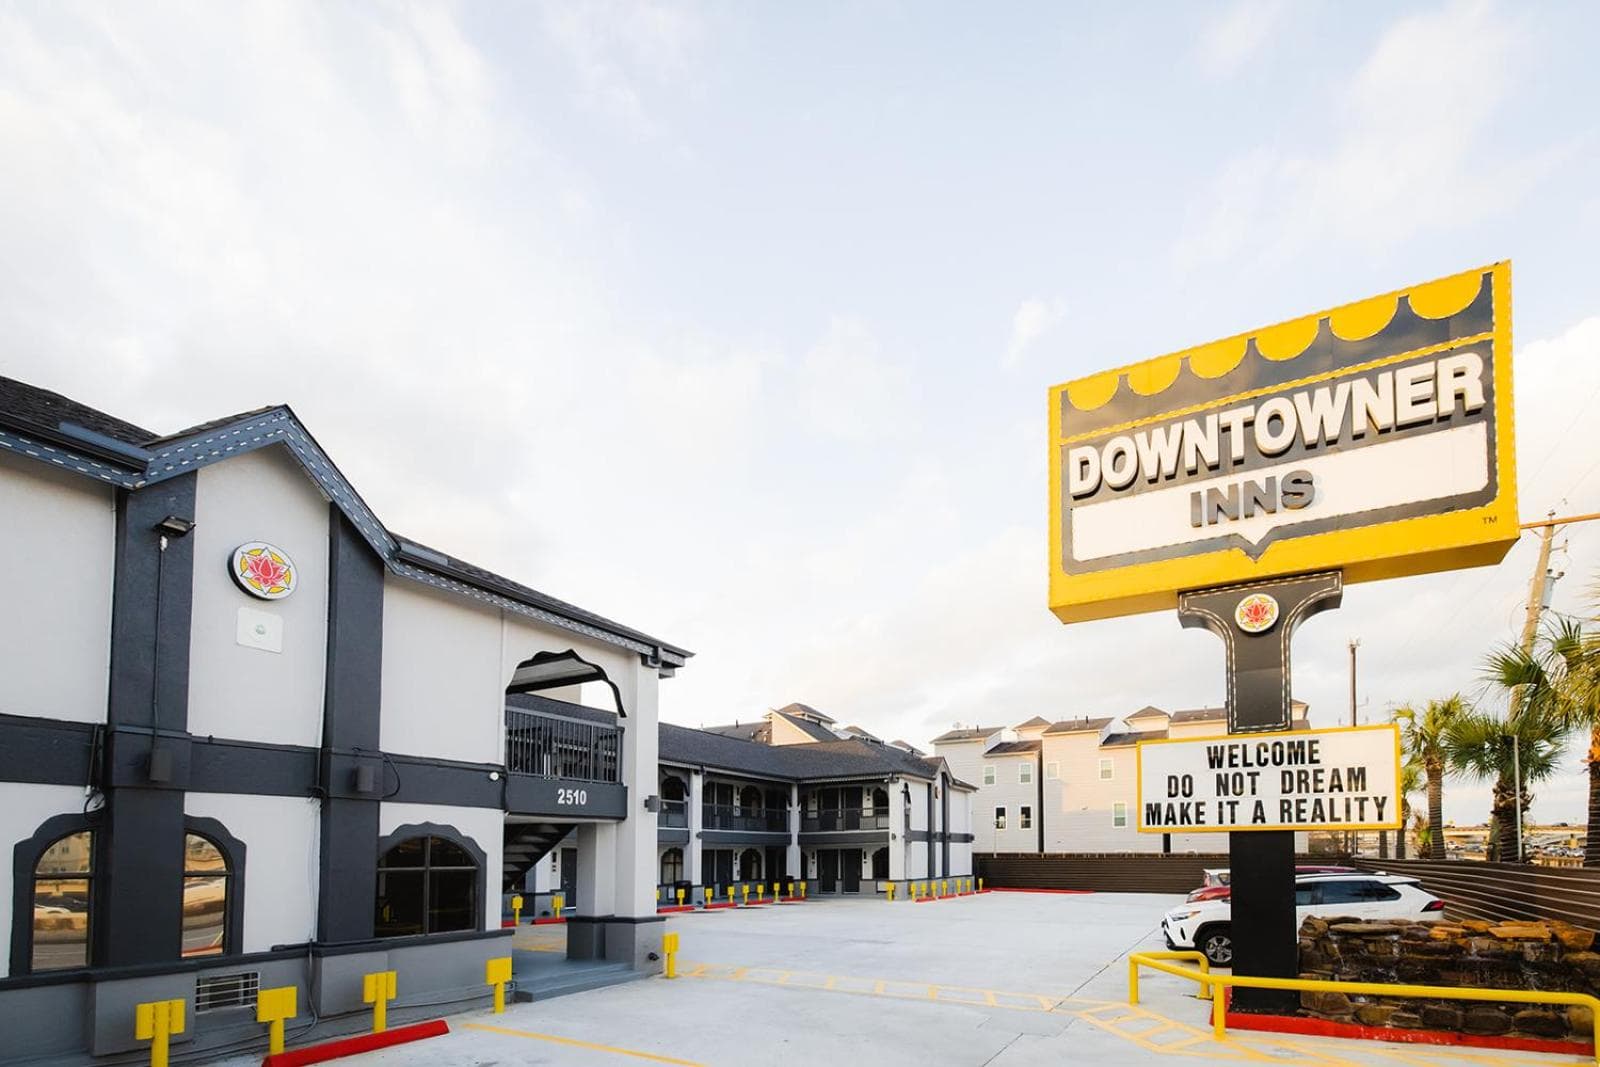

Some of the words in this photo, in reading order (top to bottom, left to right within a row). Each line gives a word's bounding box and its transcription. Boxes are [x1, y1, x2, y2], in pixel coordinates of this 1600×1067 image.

[1068, 352, 1486, 499] DOWNTOWNER
[1190, 469, 1317, 528] INNS
[1482, 515, 1498, 525] TM
[1206, 739, 1321, 769] WELCOME
[557, 788, 588, 805] 2510
[1167, 774, 1194, 798] DO
[1216, 771, 1260, 797] NOT
[1281, 766, 1367, 794] DREAM
[1145, 801, 1206, 826] MAKE
[1217, 800, 1240, 825] IT
[1251, 800, 1266, 824] A
[1279, 796, 1388, 824] REALITY
